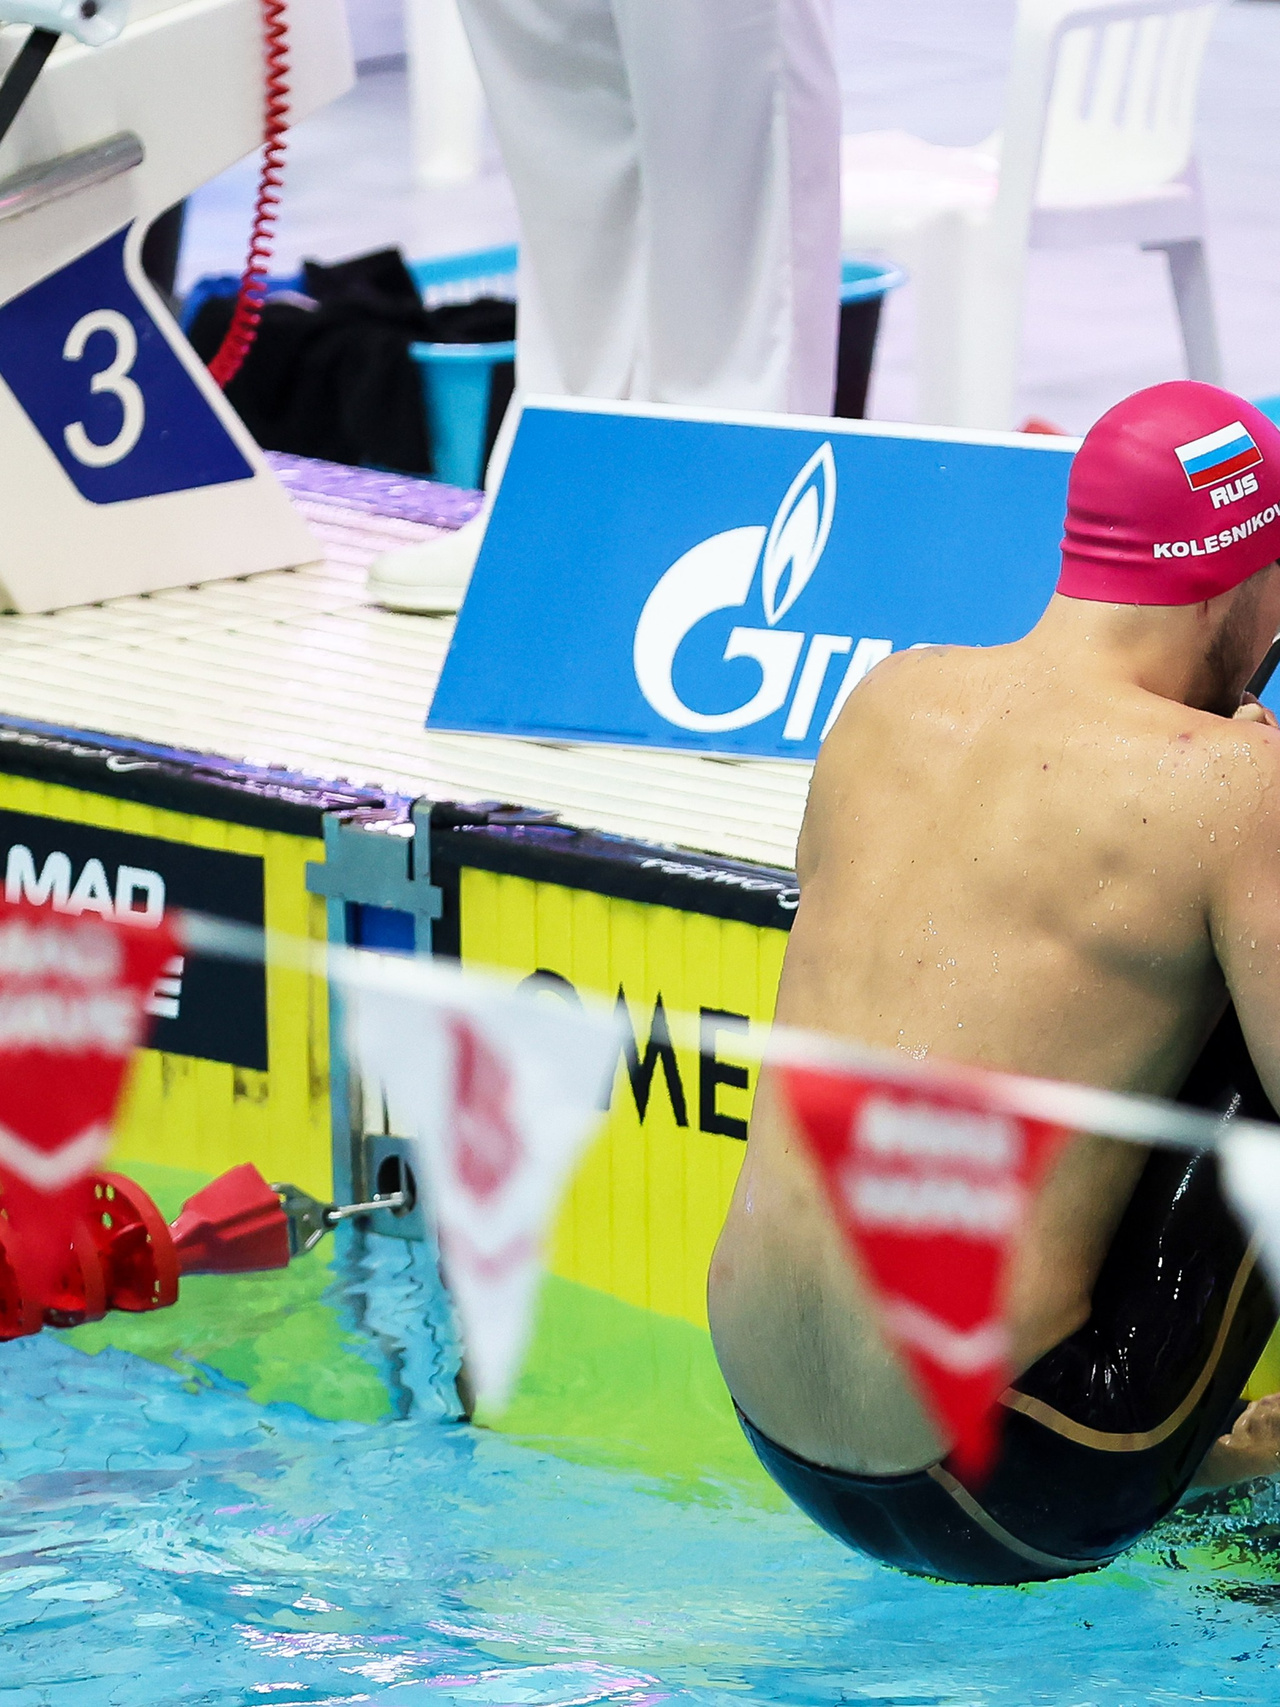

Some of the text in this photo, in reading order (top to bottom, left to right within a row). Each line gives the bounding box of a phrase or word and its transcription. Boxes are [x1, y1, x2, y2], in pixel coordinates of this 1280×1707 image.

[63, 309, 146, 468] 3
[1209, 472, 1259, 510] RUS
[5, 843, 166, 930] MAD
